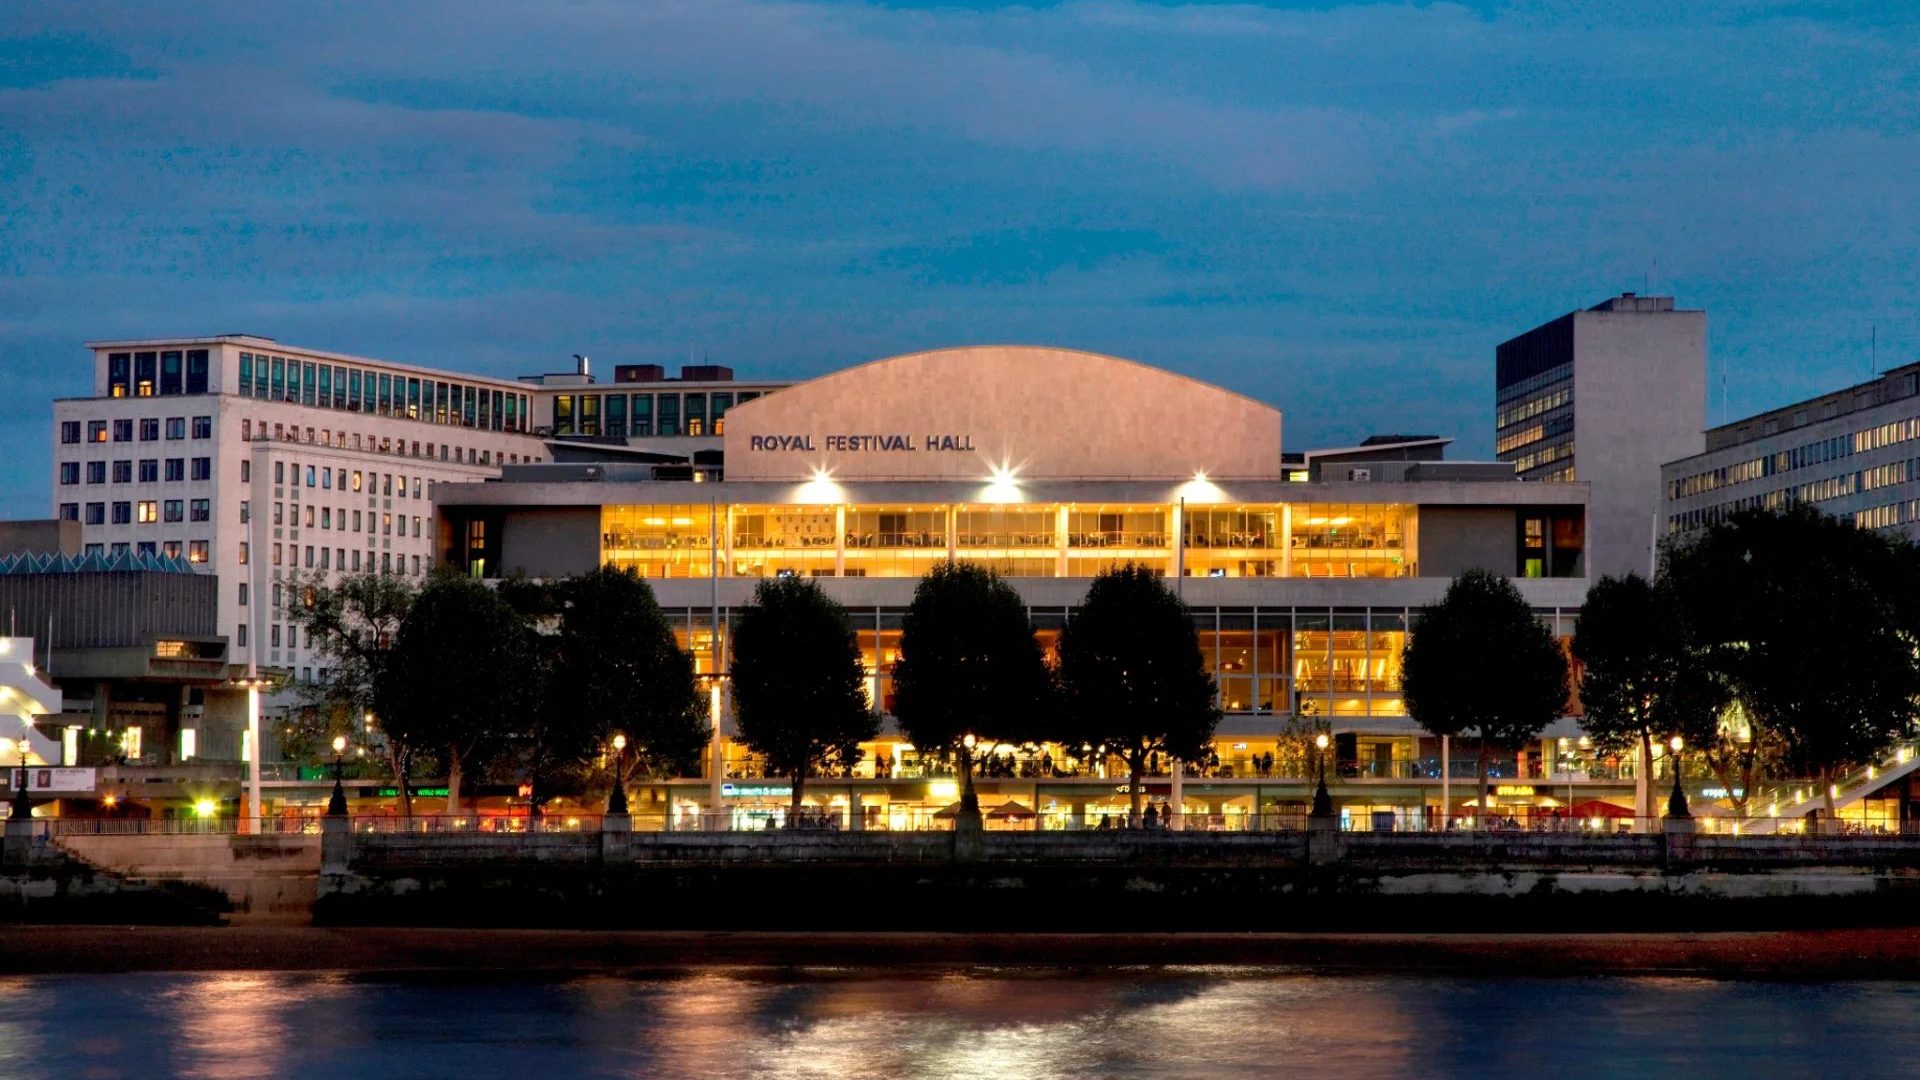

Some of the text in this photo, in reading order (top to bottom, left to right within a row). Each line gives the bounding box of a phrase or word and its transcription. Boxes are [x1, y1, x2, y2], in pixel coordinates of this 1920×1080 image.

[751, 435, 975, 451] ROYAL FESTIVAL HALL
